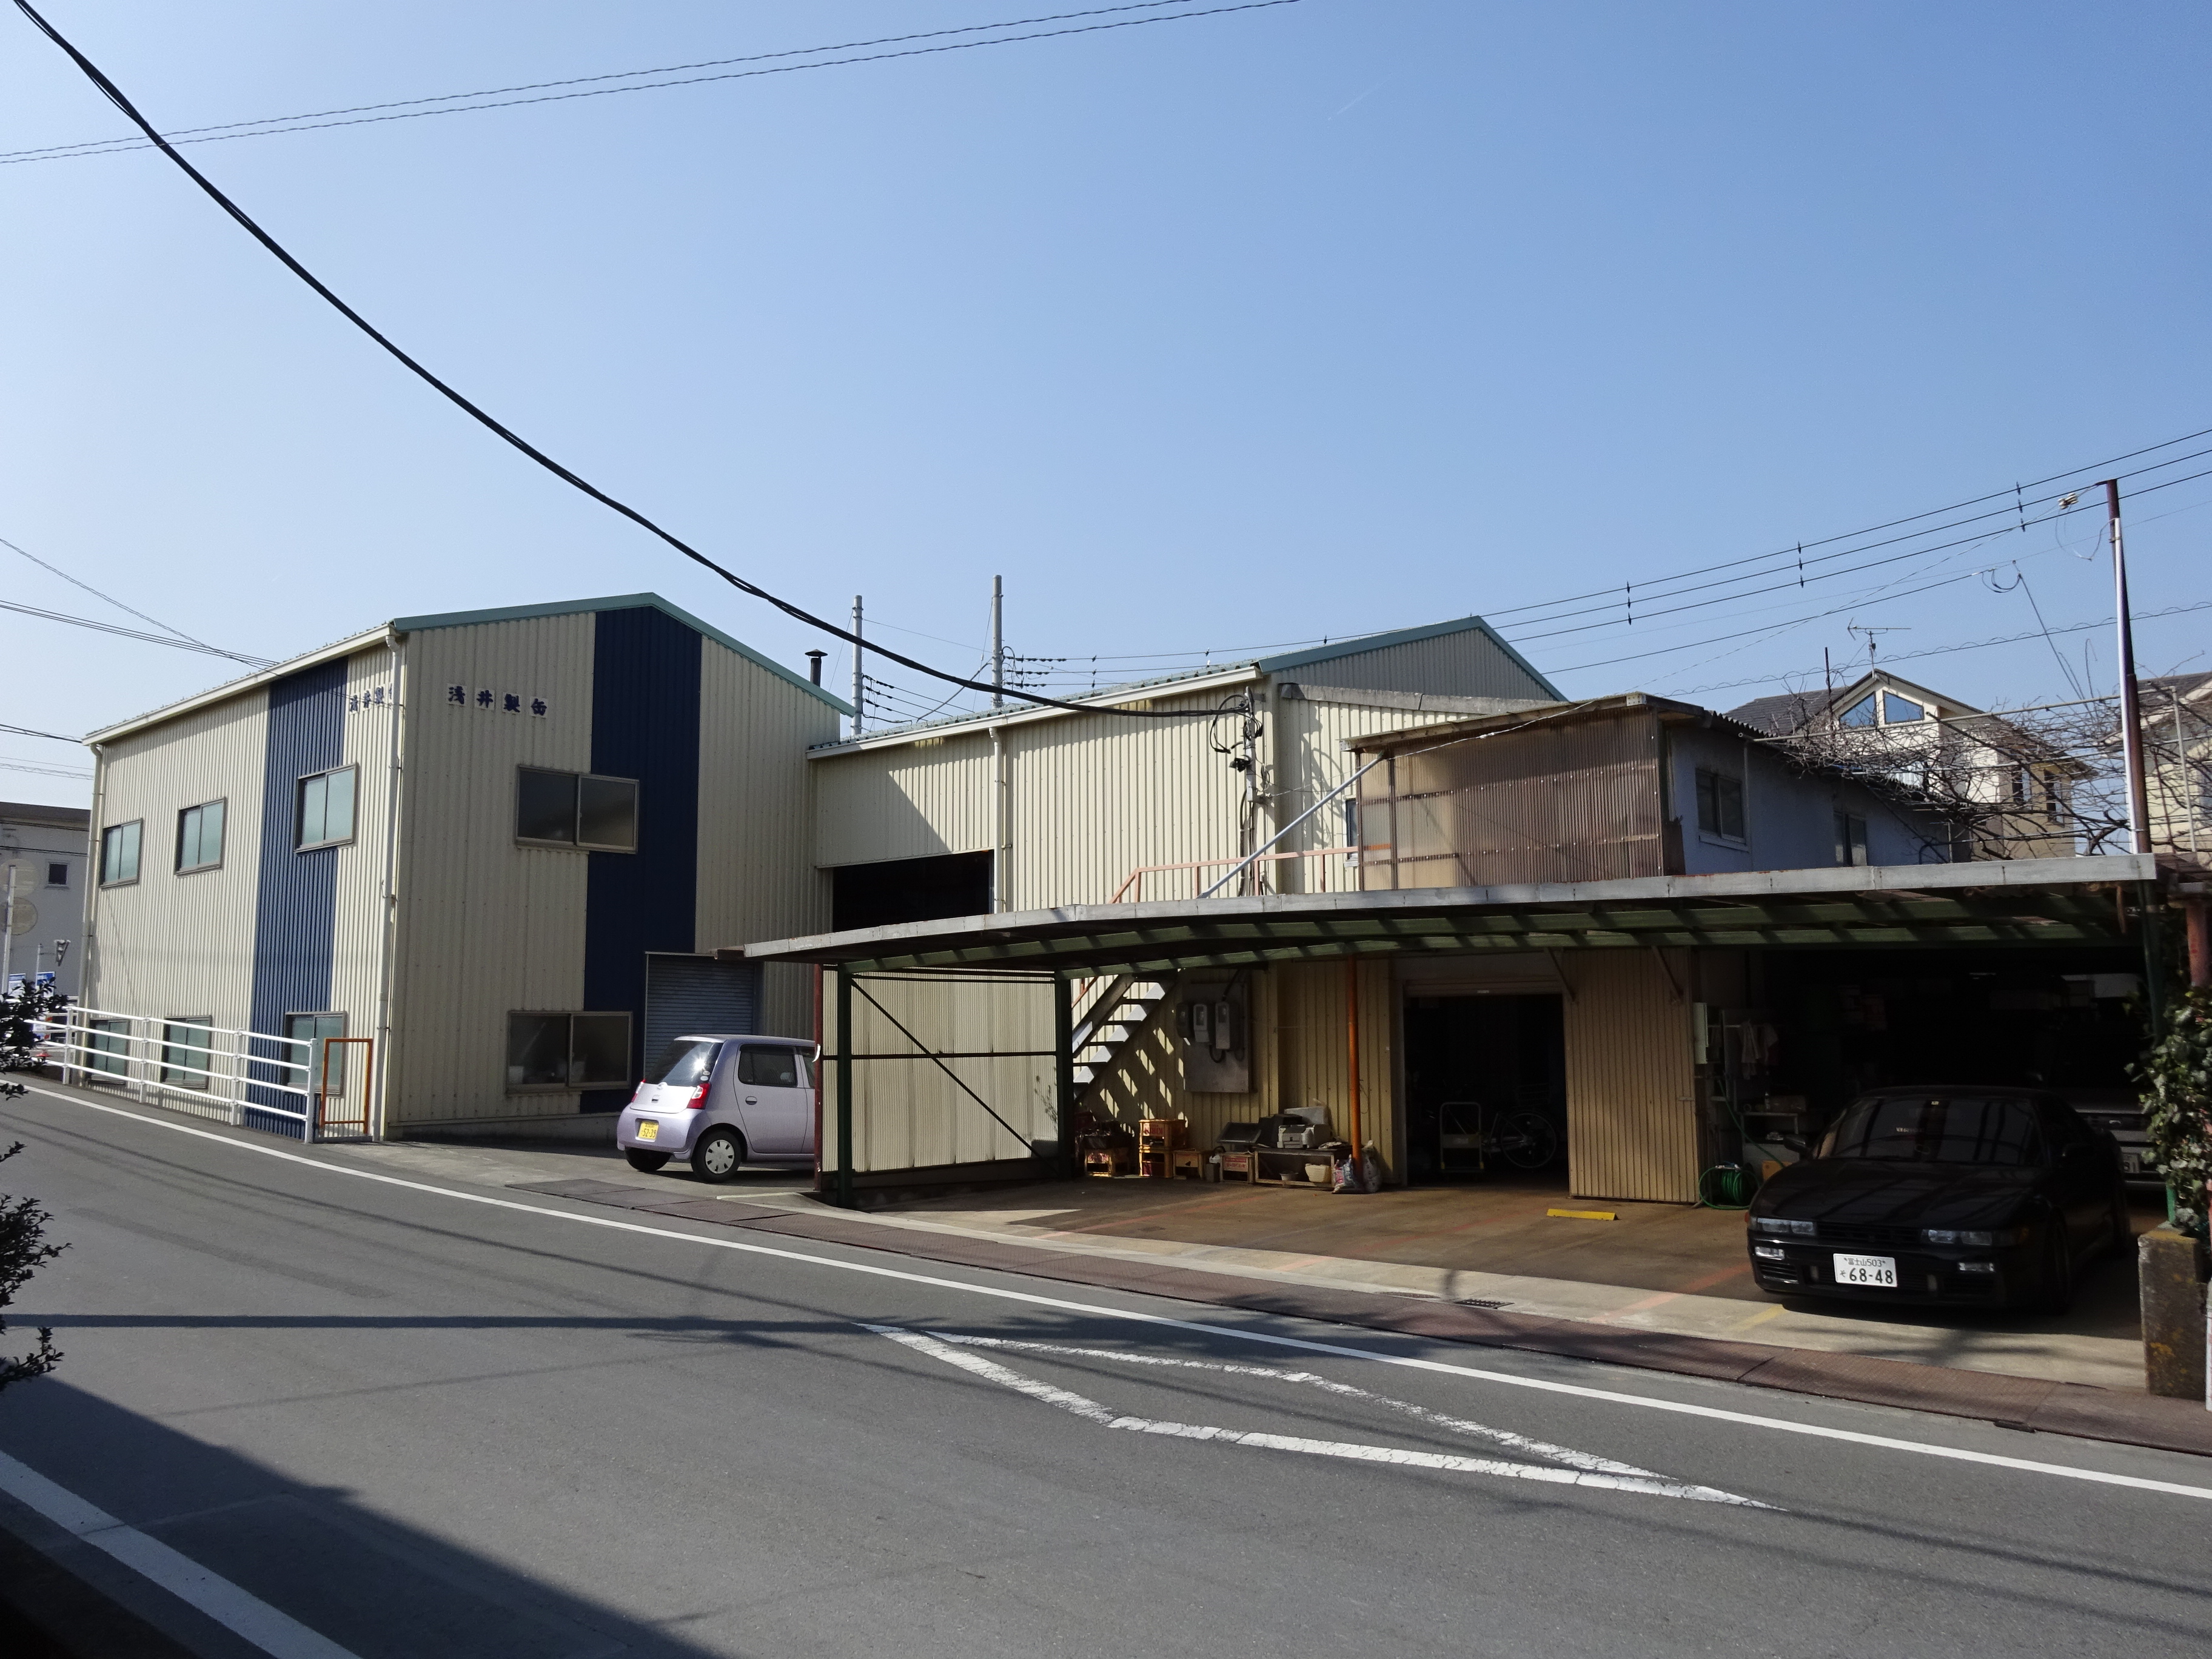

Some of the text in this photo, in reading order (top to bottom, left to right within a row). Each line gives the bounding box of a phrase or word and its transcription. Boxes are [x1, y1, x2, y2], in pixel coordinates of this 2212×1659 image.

[448, 686, 547, 716] 浅井製缶
[1849, 1267, 1893, 1284] 68-48
